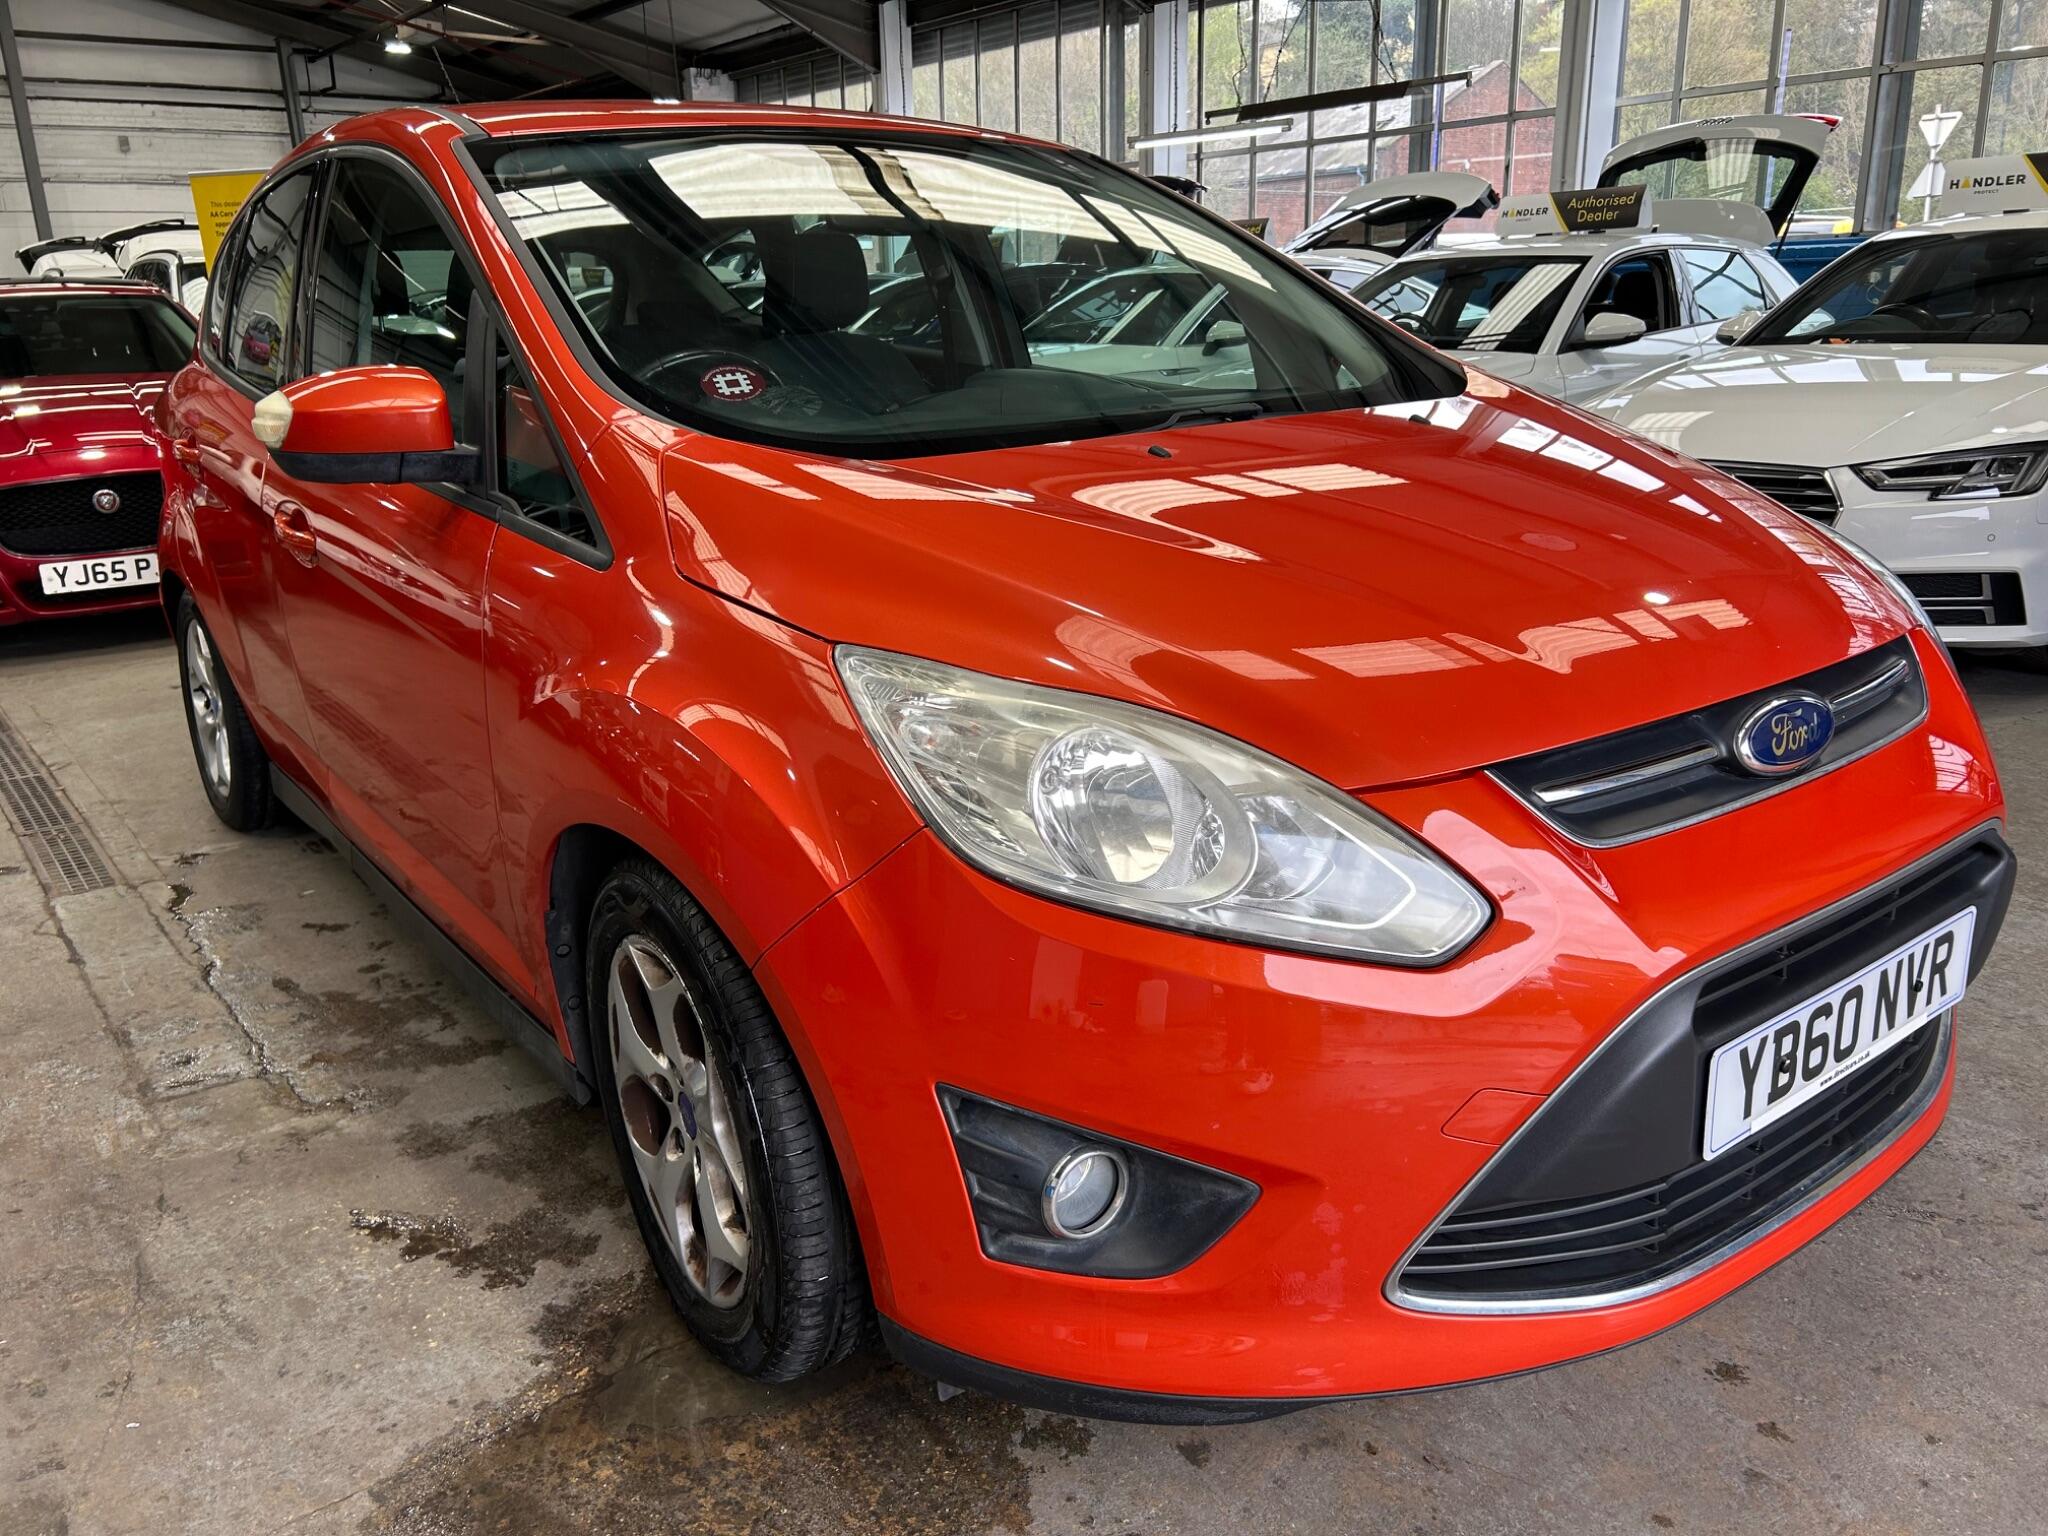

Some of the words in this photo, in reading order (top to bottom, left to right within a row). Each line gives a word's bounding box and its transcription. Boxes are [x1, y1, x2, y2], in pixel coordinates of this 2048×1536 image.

[1567, 191, 1637, 210] Authorised
[1577, 209, 1619, 223] Dealer
[53, 560, 128, 588] YJ65
[135, 558, 151, 580] P
[1771, 707, 1821, 757] Ford
[1739, 984, 1864, 1121] YB60
[1872, 930, 1955, 1042] NVR
